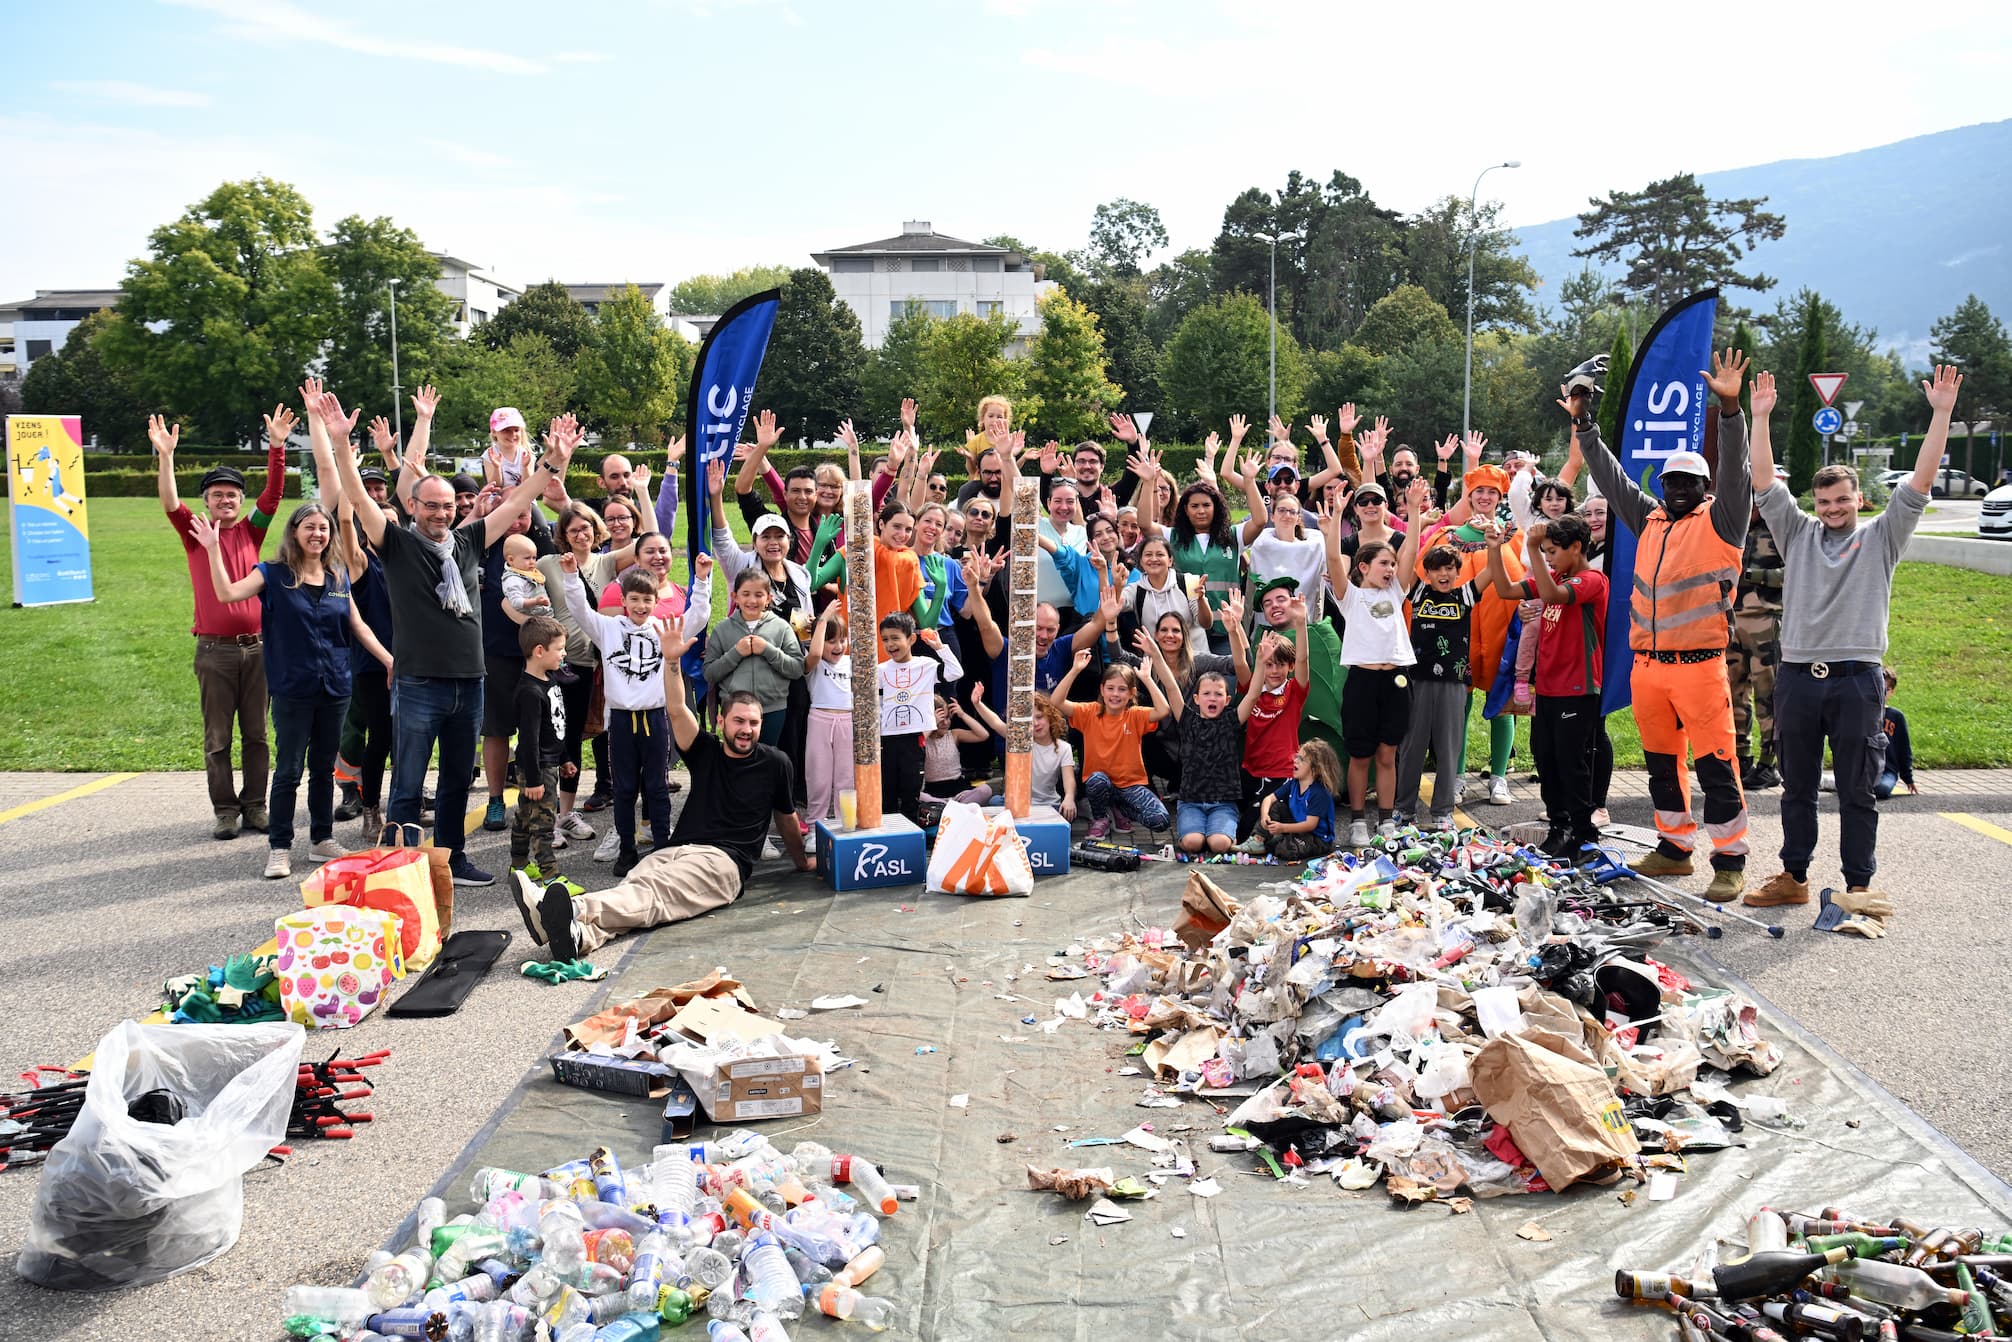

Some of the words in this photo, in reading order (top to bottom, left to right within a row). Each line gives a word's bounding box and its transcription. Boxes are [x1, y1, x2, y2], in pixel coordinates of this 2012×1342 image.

[15, 421, 42, 429] VIENS
[1692, 383, 1704, 453] ECYCLAGE
[16, 431, 43, 441] JOUER
[1030, 851, 1054, 868] SL
[873, 859, 912, 878] ASL
